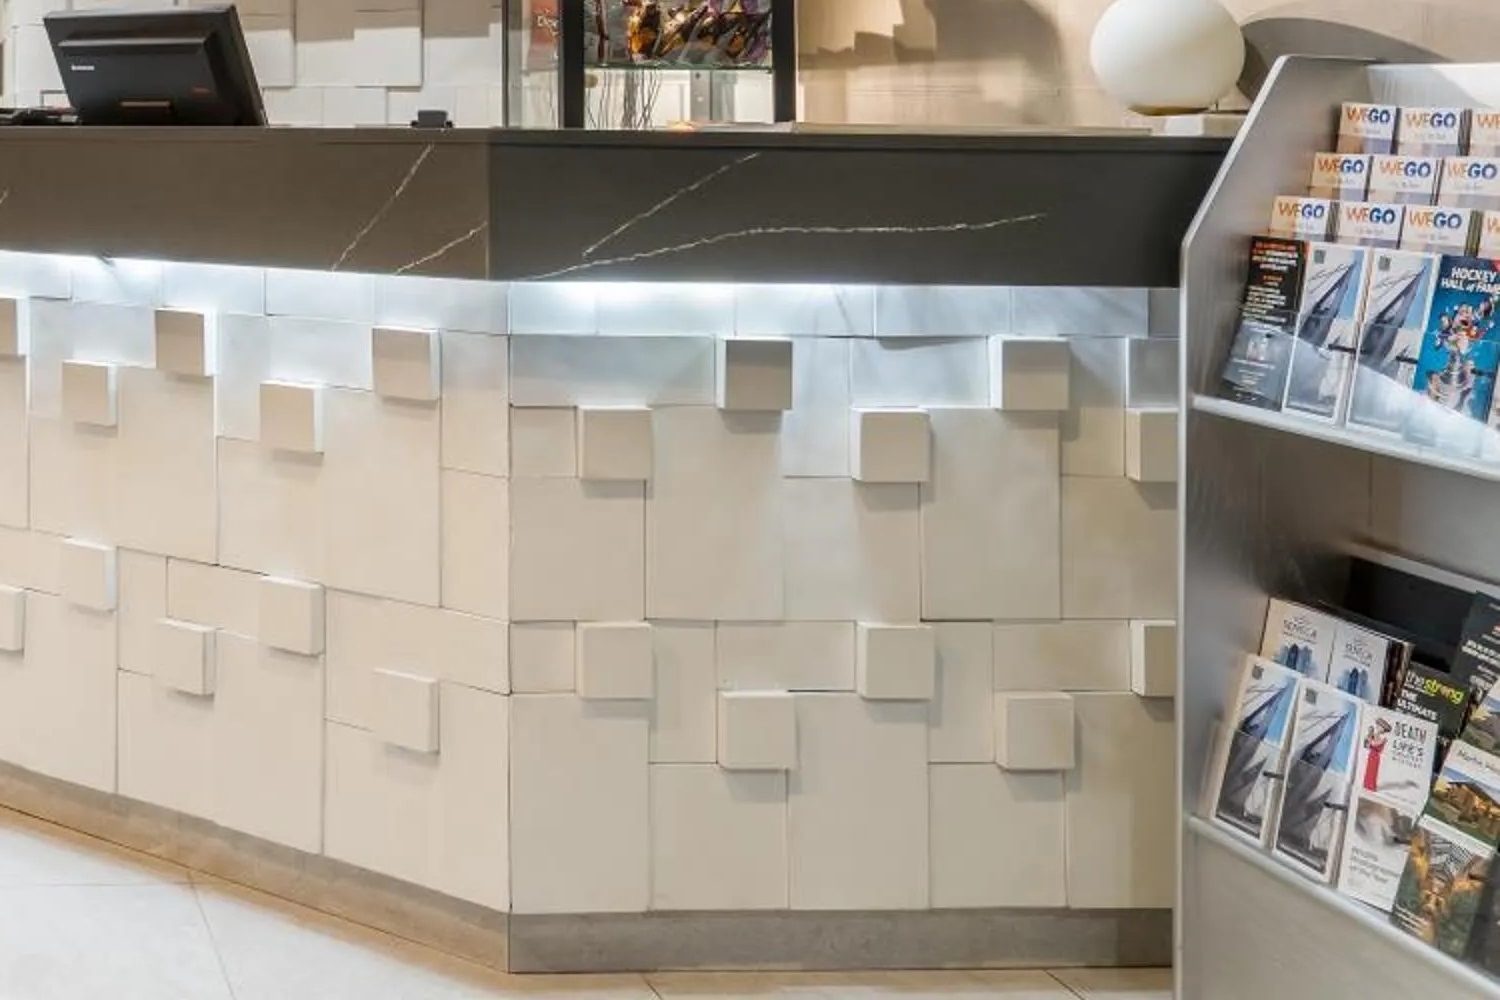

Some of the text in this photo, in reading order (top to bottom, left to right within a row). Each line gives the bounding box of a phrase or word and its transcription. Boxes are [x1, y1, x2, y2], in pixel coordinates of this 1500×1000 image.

[1345, 107, 1391, 124] WEGO
[1405, 112, 1457, 129] WEGO
[1317, 158, 1365, 175] WEGO
[1379, 160, 1431, 178] WEGO
[1447, 163, 1498, 180] WEGO
[1278, 202, 1325, 219] WEGO
[1345, 206, 1396, 225] WEGO
[1408, 210, 1463, 230] WEGO
[1451, 266, 1497, 284] HOCKEY
[1441, 277, 1464, 291] HALL
[1397, 698, 1438, 721] ULTIMATE
